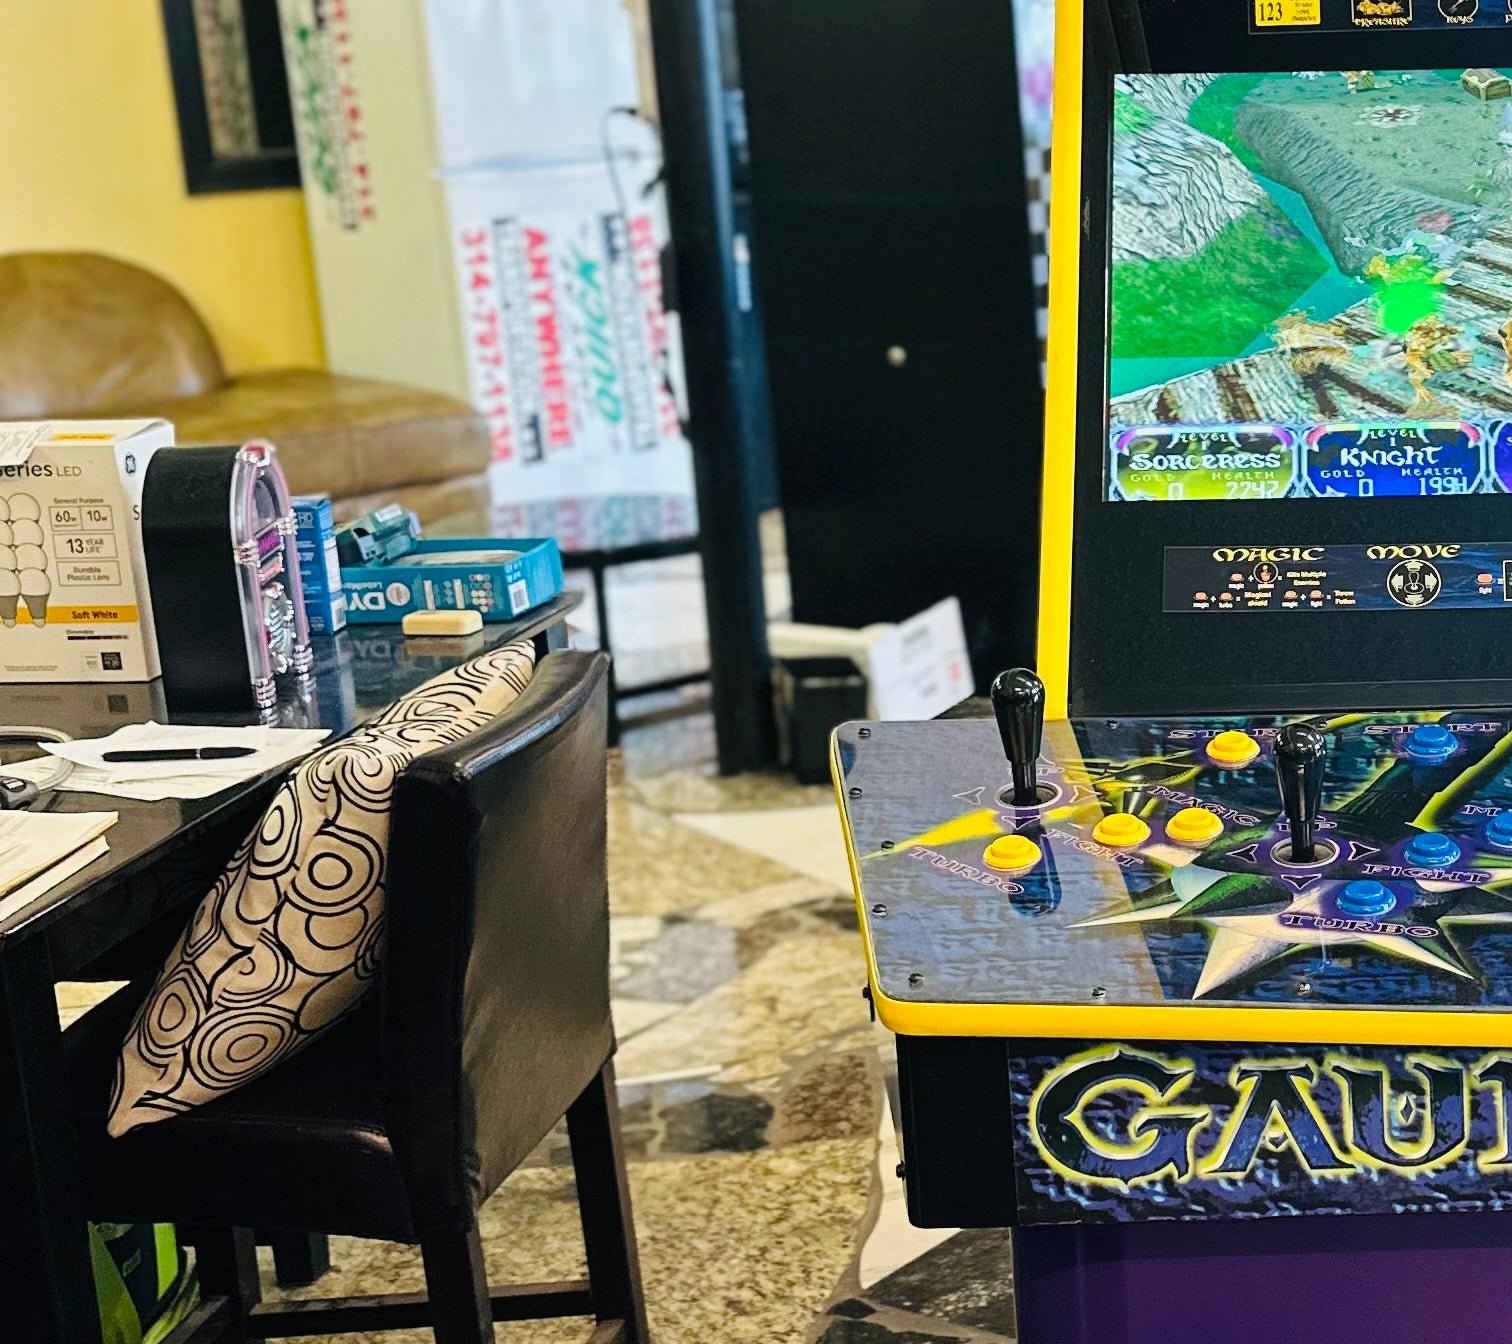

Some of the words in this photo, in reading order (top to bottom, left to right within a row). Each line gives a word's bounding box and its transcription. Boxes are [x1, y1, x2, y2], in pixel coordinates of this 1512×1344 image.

[1259, 2, 1283, 21] 123
[524, 227, 572, 447] ANYWHERE
[56, 465, 82, 477] LED
[1130, 474, 1175, 482] GOLD
[1211, 471, 1275, 481] HEALTH
[1320, 470, 1365, 478] GOLD
[1401, 467, 1464, 477] HEALTH
[66, 538, 84, 554] 13
[1366, 544, 1461, 560] MOVE
[1212, 547, 1326, 563] MAGIC
[72, 611, 90, 620] Soft
[91, 610, 118, 619] White
[1364, 722, 1502, 734] STRT
[1148, 784, 1262, 827] MAGIC
[1043, 829, 1144, 868] FIGHT
[909, 846, 1025, 894] TURBO
[1361, 863, 1490, 884] FIGHT
[1282, 914, 1439, 938] TURBO
